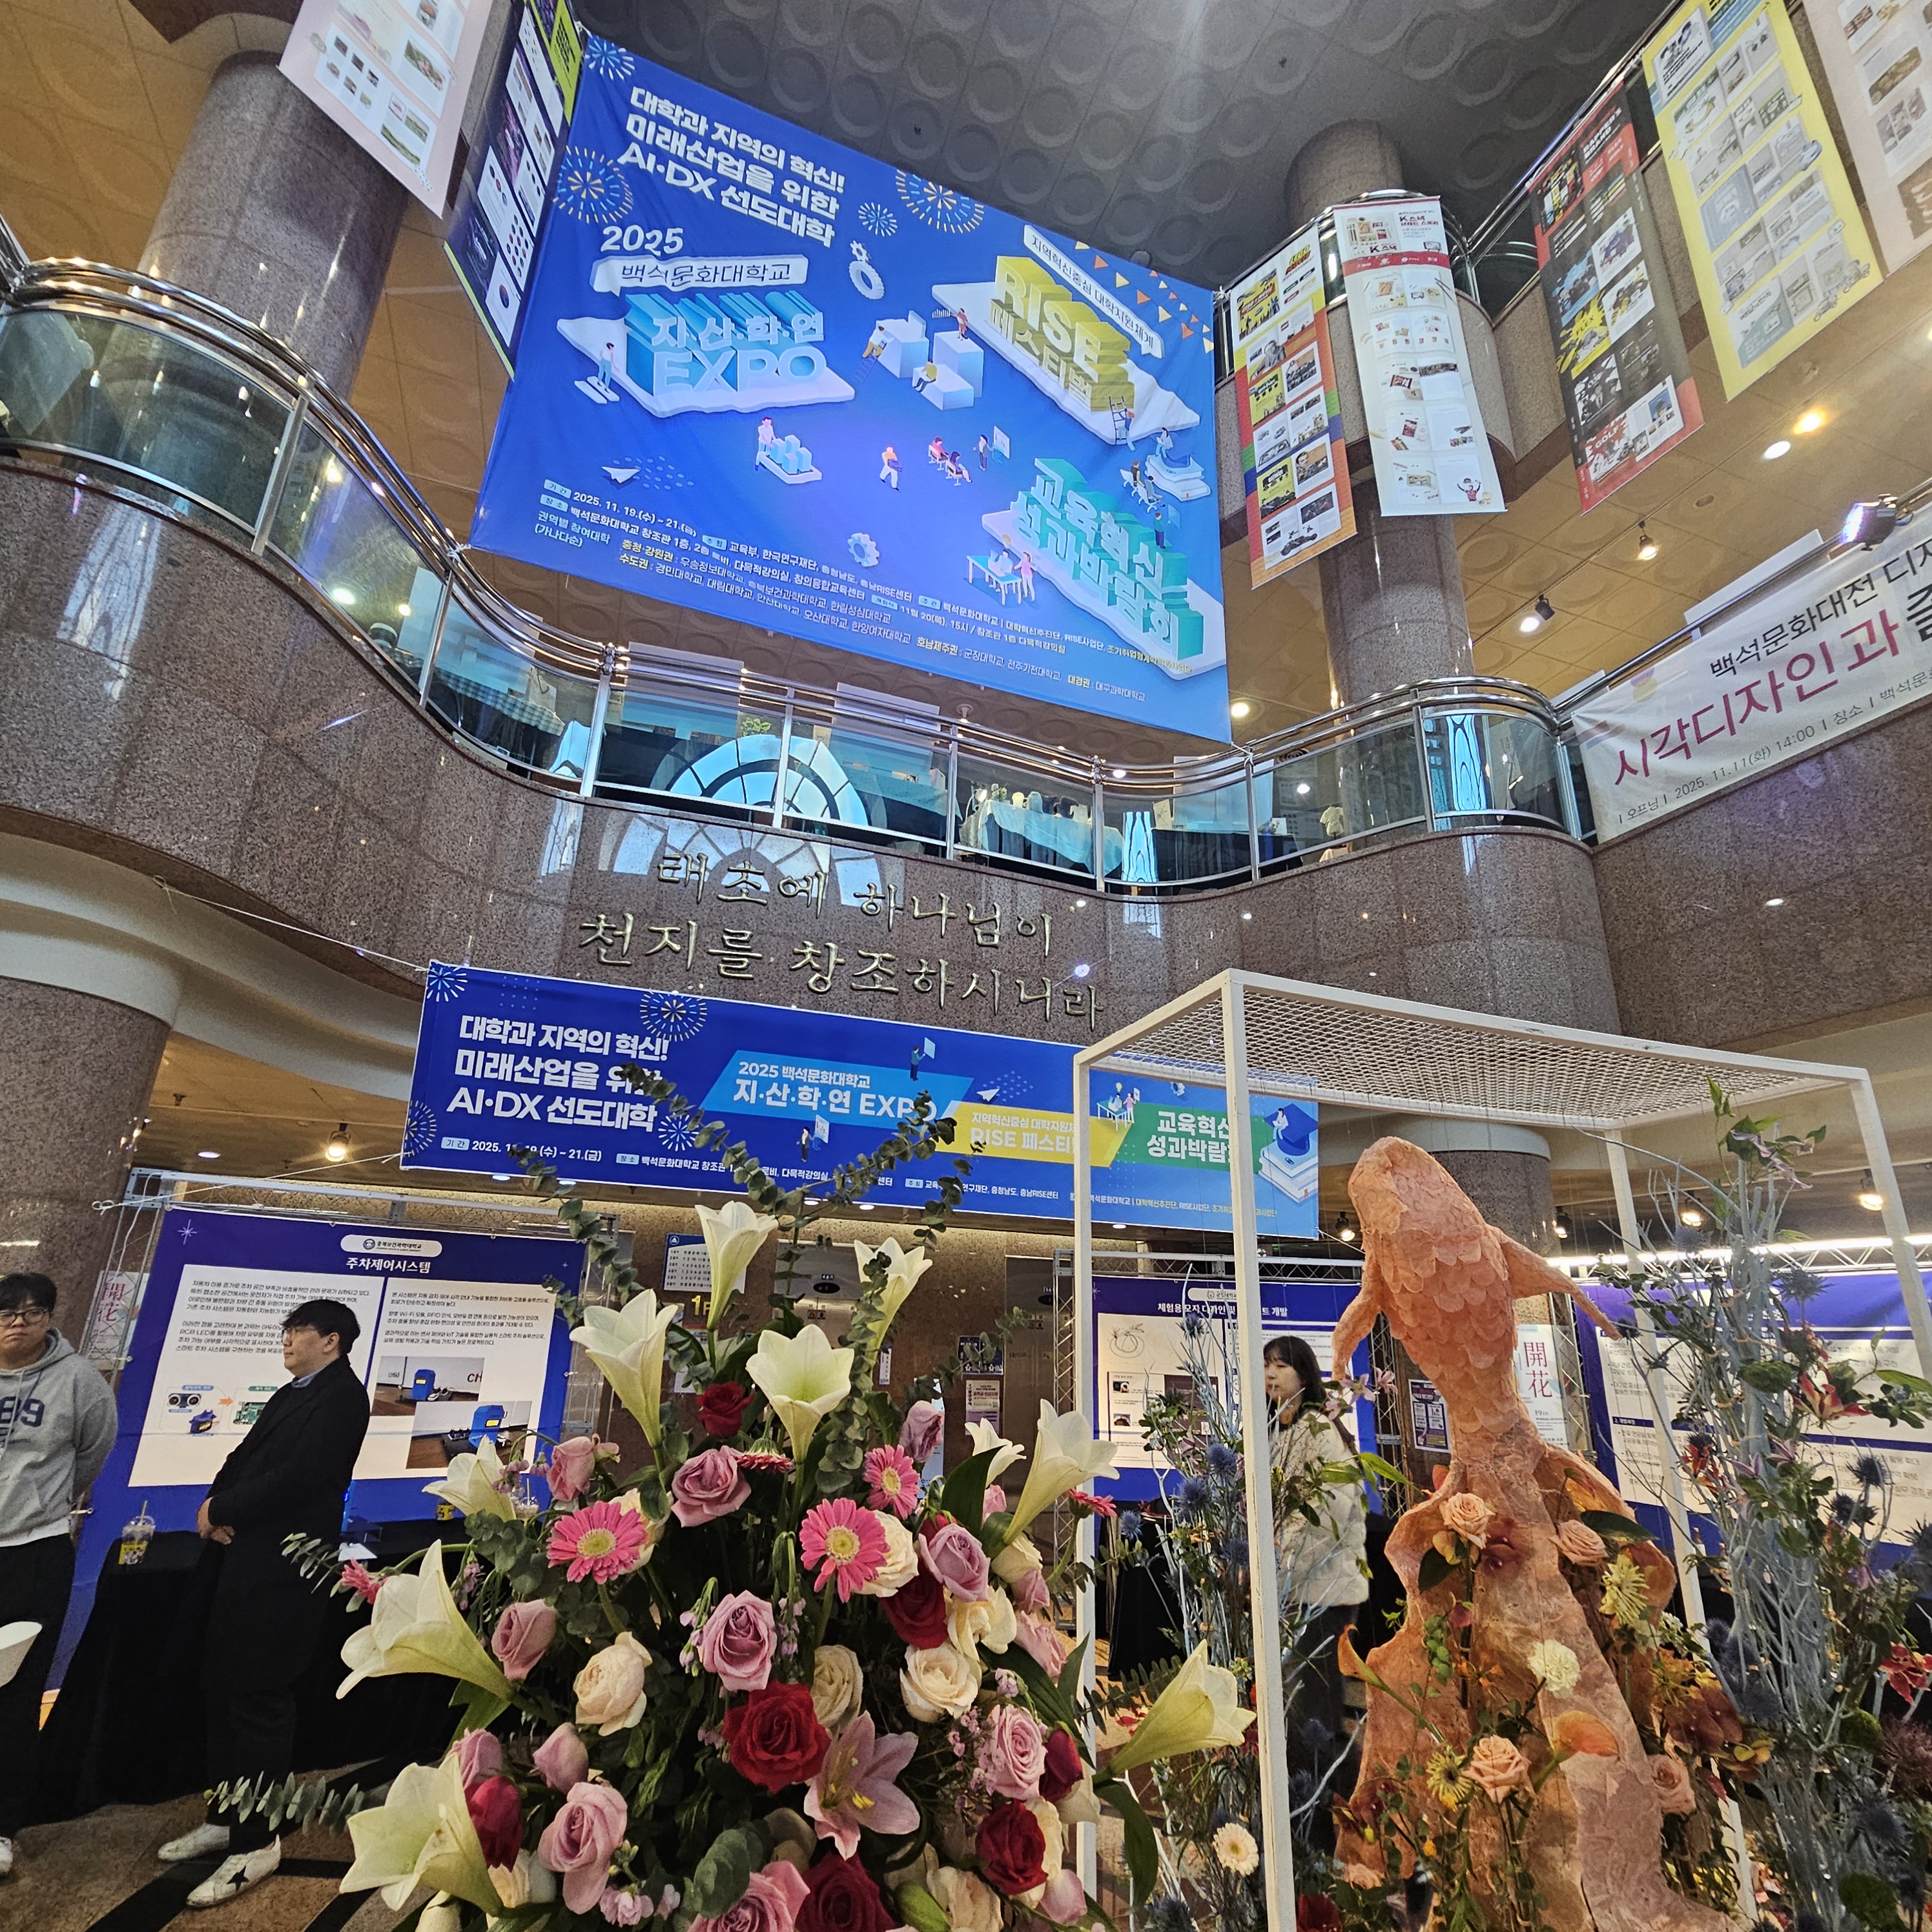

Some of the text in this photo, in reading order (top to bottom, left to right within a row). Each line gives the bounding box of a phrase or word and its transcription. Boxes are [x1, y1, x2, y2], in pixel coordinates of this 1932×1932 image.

[630, 87, 845, 192] 대학과 지역의 혁신!
[1584, 126, 1612, 159] BRAND
[626, 114, 839, 219] 미래산업을 위한
[601, 225, 683, 256] 2025
[721, 182, 835, 248] 선도대학
[622, 263, 790, 287] 백석문화대학교
[1032, 234, 1153, 349] 지역혁신중심 대학지원체계
[996, 263, 1100, 383] RISE
[1575, 315, 1595, 337] FLEX
[653, 345, 827, 393] EXPO
[991, 300, 1091, 411] 페스티벌
[1595, 425, 1619, 449] GOLF
[535, 524, 583, 548] (가나다순)
[538, 511, 610, 544] 권역별 참여대학
[1031, 458, 1163, 599] 교육혁신
[570, 506, 639, 536] 백석문화대학교
[642, 527, 672, 546] 창조관
[694, 543, 710, 556] 2층
[794, 573, 865, 601] 창의융합교육센터
[901, 606, 919, 618] 11월
[951, 620, 969, 633] 15시
[977, 626, 1002, 641] 창조관
[1004, 633, 1016, 644] 1층
[1019, 636, 1066, 654] 다목적강의실
[573, 492, 602, 507] 2025.
[606, 501, 620, 513] 11.
[763, 549, 819, 572] 한국연구재단,
[860, 579, 912, 602] 충남RISE센터
[943, 601, 998, 626] 백석문화대학교
[1010, 493, 1178, 661] 성과박람회
[619, 553, 649, 570] 수도권
[852, 621, 911, 644] 한양여자대학교
[1068, 674, 1090, 688] 대경권
[1095, 681, 1146, 702] 대구과학대학교
[831, 600, 891, 624] 한림성심대학교
[1709, 577, 1878, 678] 백석문화대전
[1614, 608, 1900, 786] 시각디자인과
[1626, 797, 1659, 821] 오프닝
[1674, 777, 1709, 800] 2025.
[1774, 725, 1816, 752] 14:00
[1833, 703, 1864, 726] 장소
[1879, 666, 1932, 699] 백석문
[656, 852, 1053, 958] 태초에 하나님이
[579, 912, 1104, 1032] 천지를 창조하시니라
[459, 1014, 670, 1062] 대학과 지역의 혁신!
[455, 1049, 600, 1091] 미래산업을
[738, 1060, 871, 1090] 2025 백석문화대학교
[546, 1094, 658, 1133] 선도대학
[971, 1112, 1029, 1129] 지역혁신중심
[970, 1127, 1076, 1154] RISE 페스티
[1146, 1134, 1233, 1163] 성과박람
[471, 1140, 502, 1153] 2025.
[568, 1149, 602, 1162] 21.(금)
[641, 1156, 699, 1170] 백석문화대학교
[1020, 1190, 1058, 1200] 충남RISE센터
[345, 1257, 431, 1273] 주차제어시스템
[1158, 1303, 1182, 1313] 체험용
[1271, 1307, 1288, 1317] 개발
[1523, 1341, 1553, 1398] 開花
